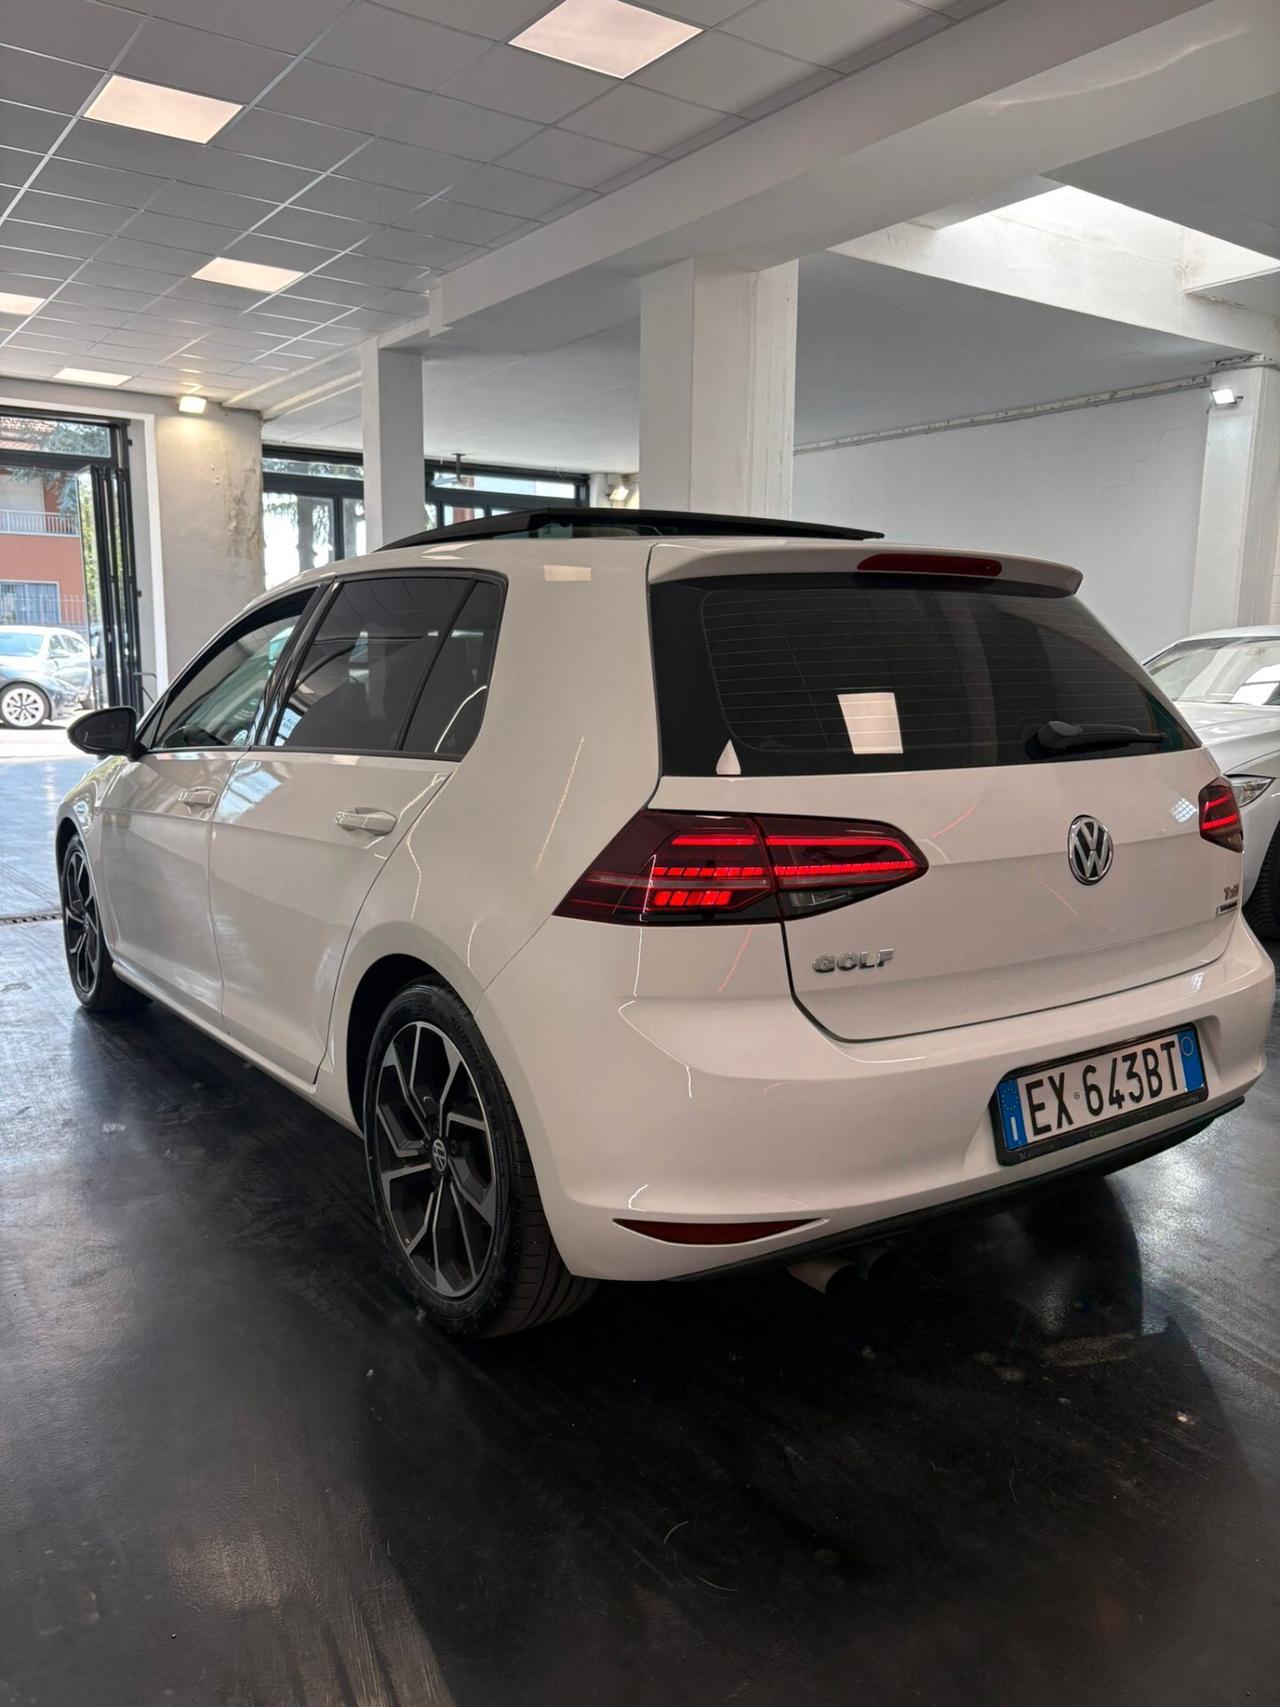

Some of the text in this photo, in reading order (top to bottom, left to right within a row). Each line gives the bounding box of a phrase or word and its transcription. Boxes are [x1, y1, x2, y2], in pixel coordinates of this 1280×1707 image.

[812, 948, 895, 973] GOLF
[1025, 1072, 1074, 1136] EX
[1082, 1040, 1178, 1117] 643BT
